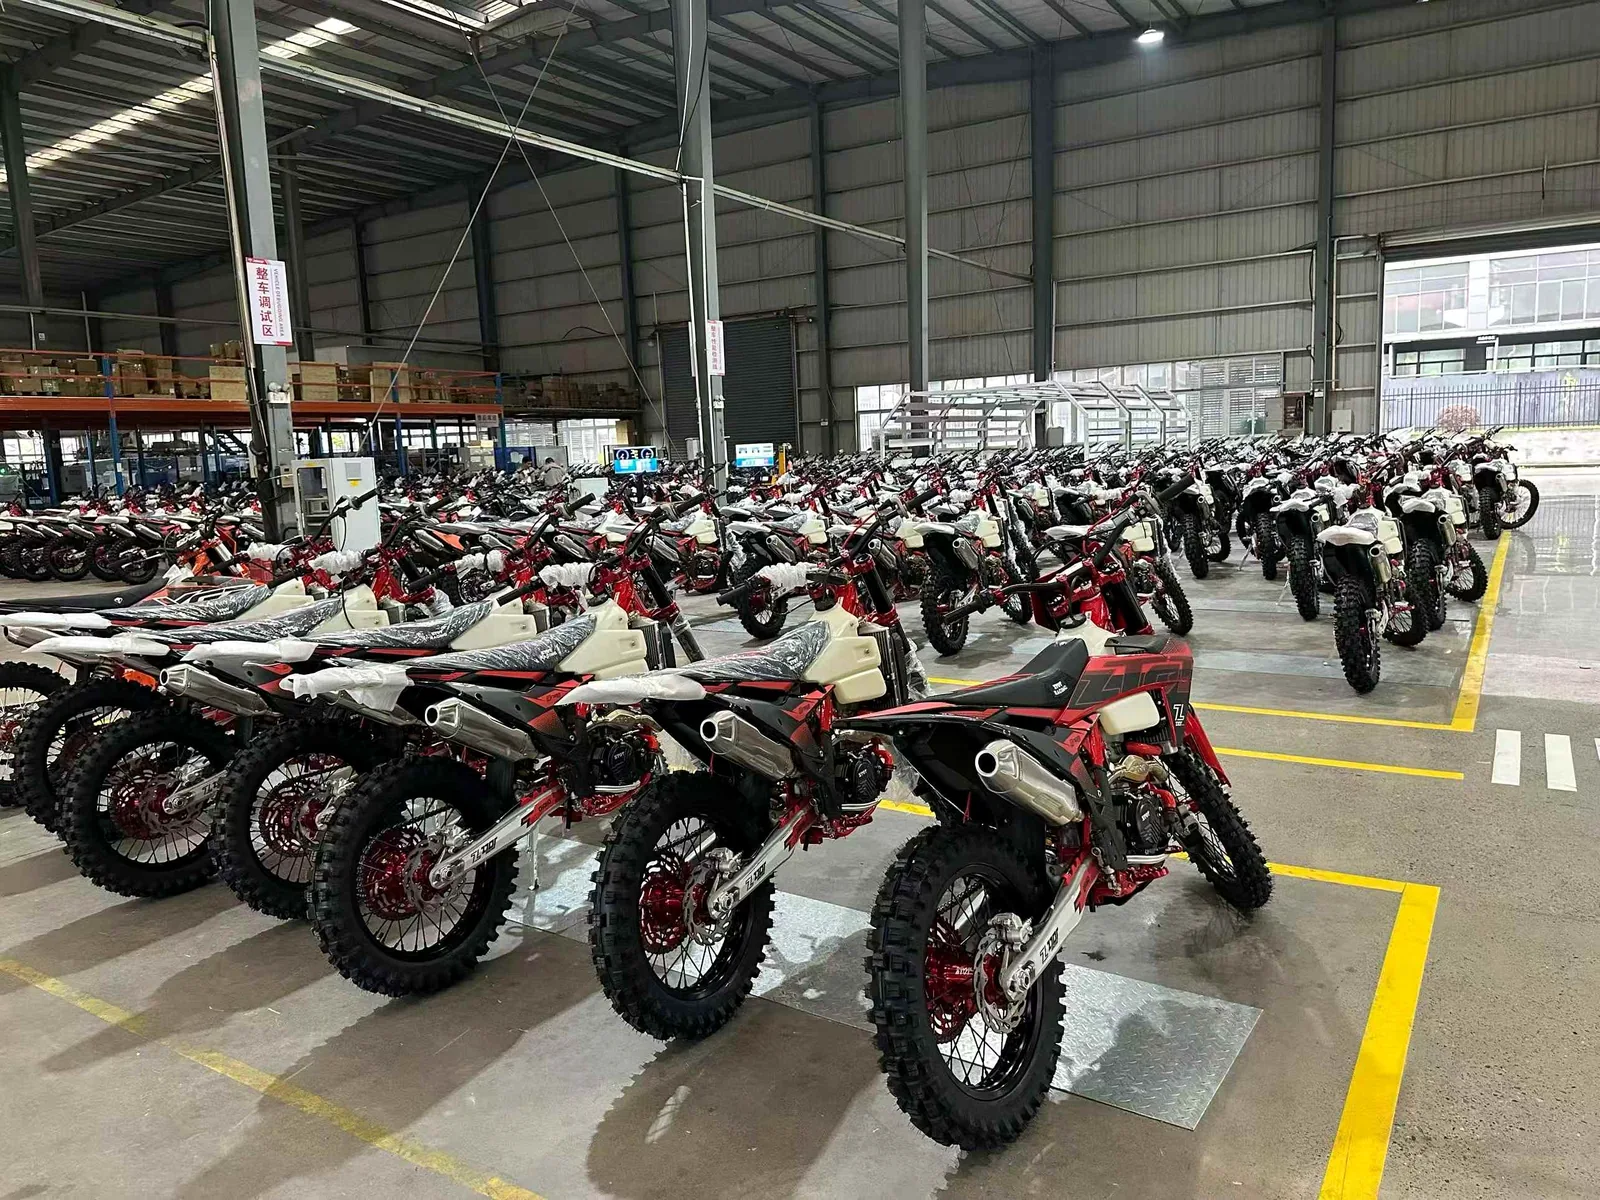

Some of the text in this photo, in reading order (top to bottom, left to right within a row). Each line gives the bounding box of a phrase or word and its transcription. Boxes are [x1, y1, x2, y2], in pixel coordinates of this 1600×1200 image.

[255, 267, 274, 337] 整车调试区
